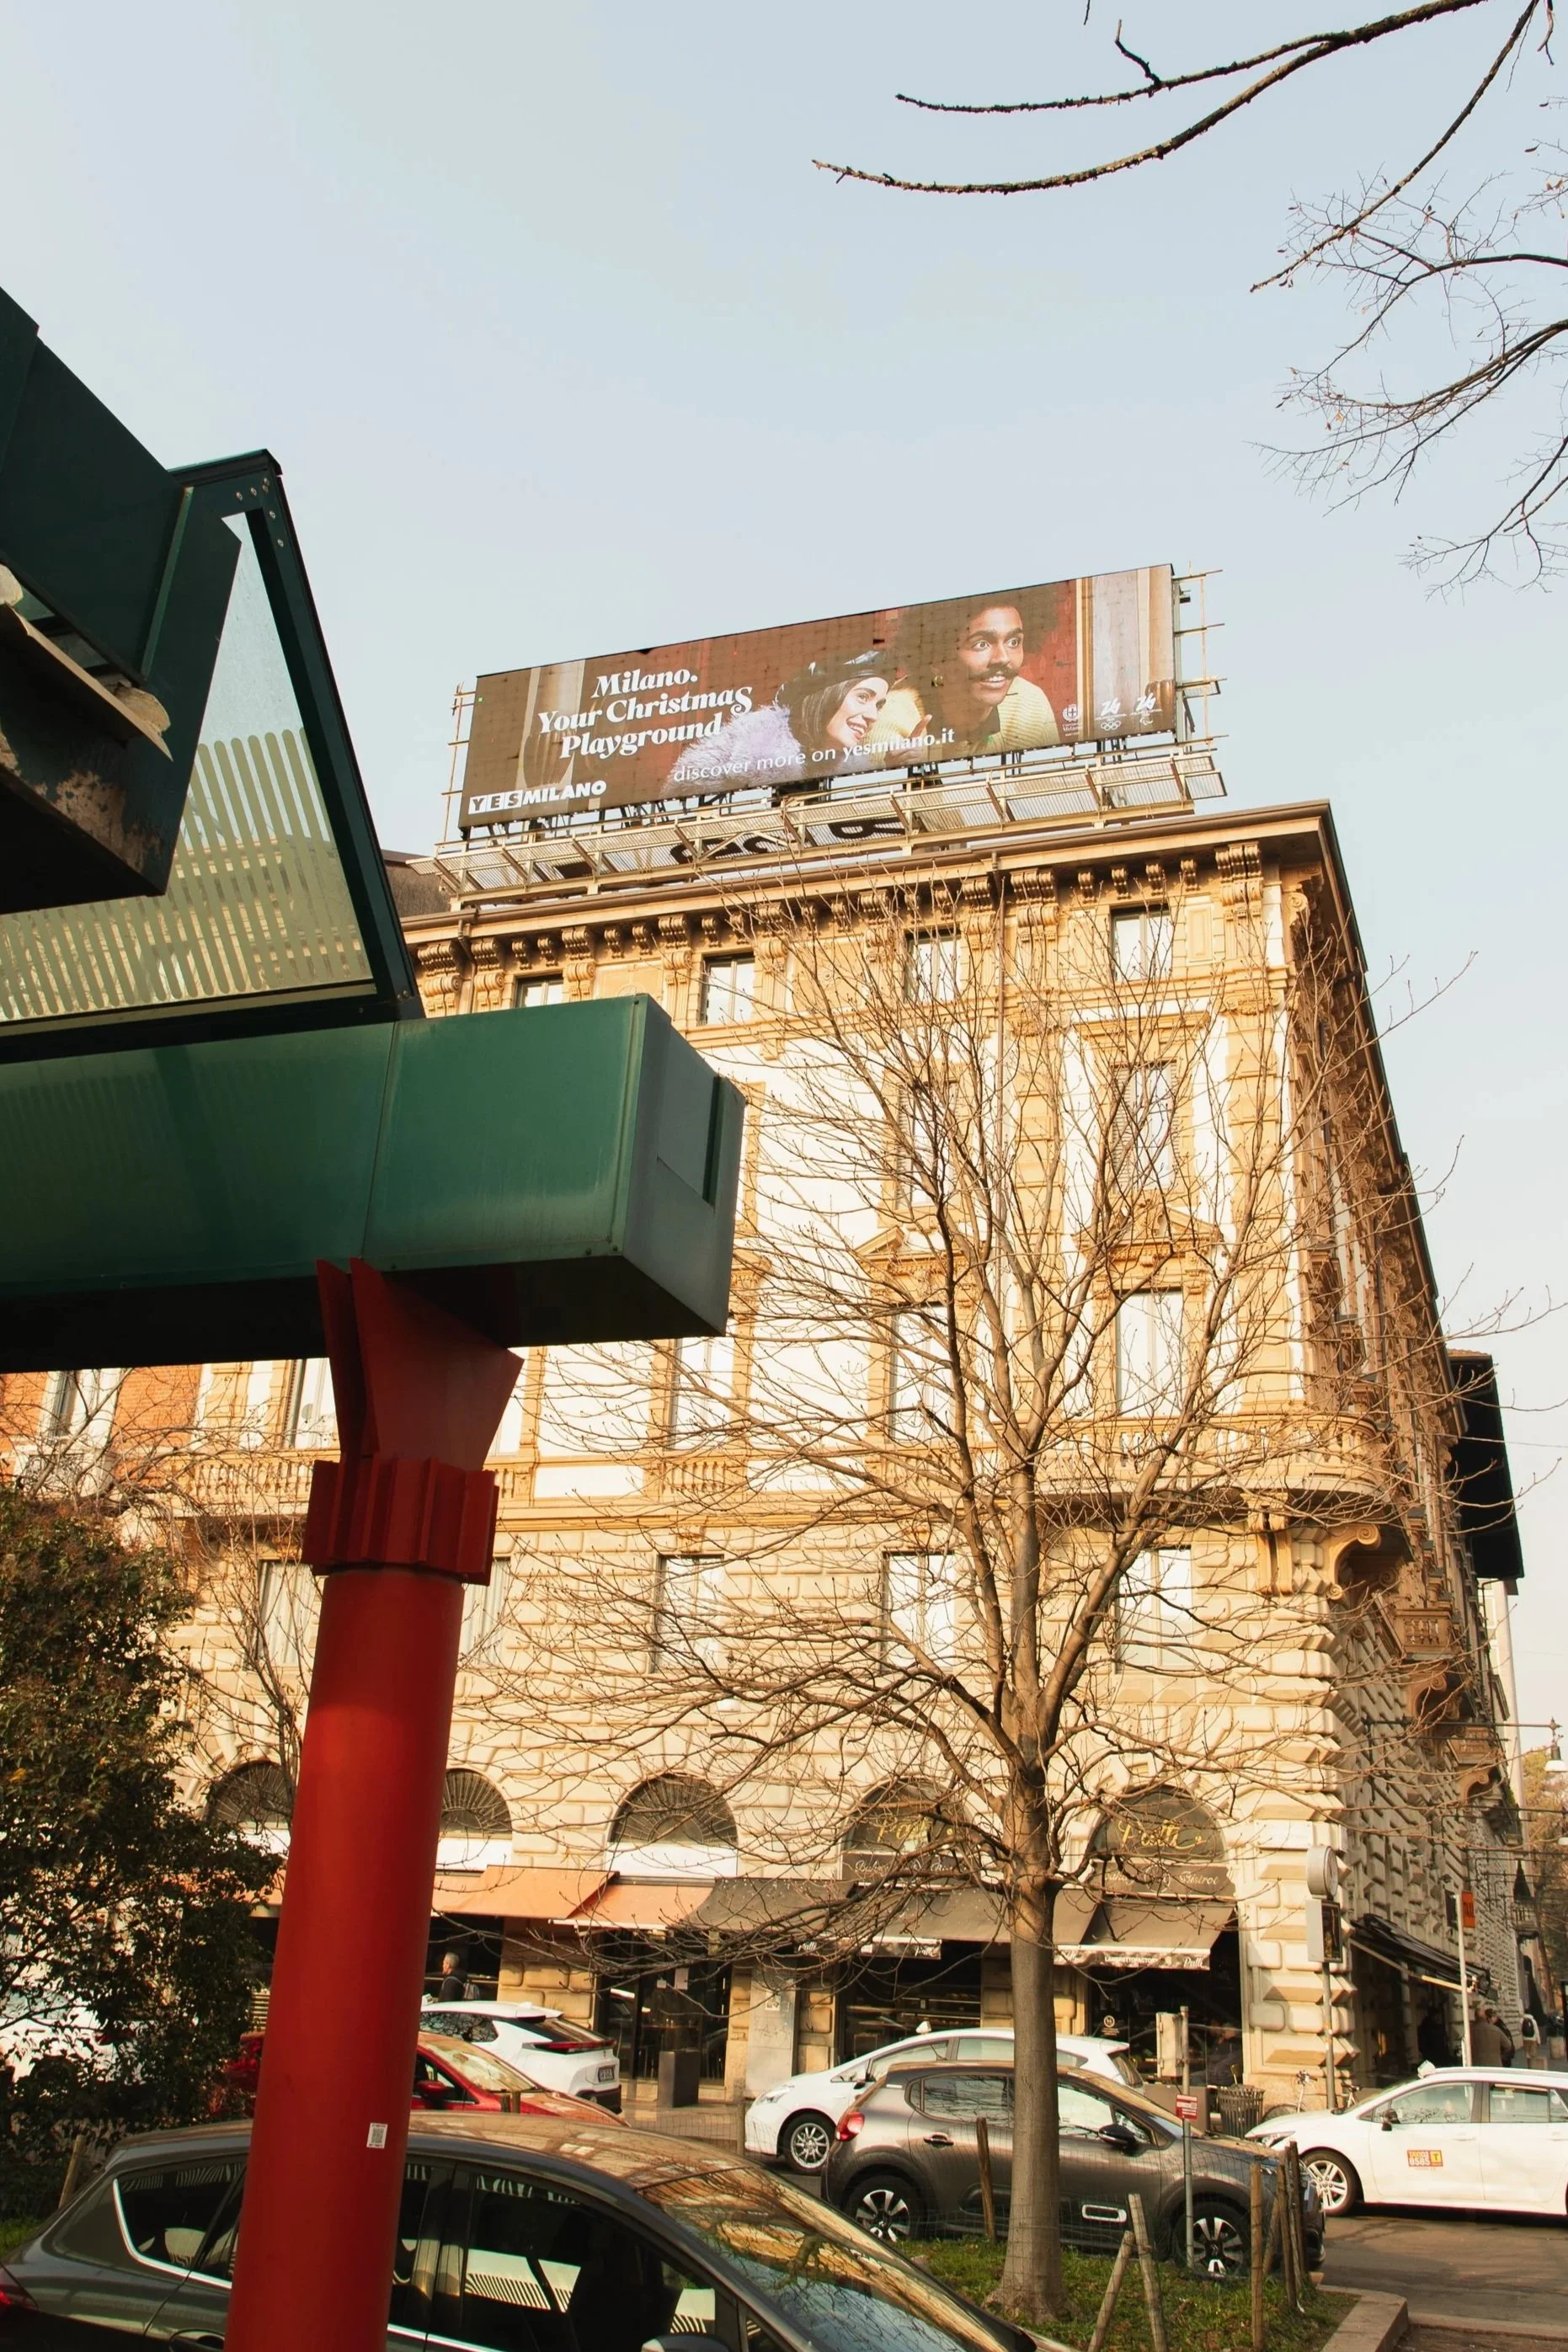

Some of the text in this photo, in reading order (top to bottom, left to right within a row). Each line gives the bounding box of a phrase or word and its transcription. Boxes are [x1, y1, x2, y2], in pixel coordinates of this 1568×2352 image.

[591, 668, 698, 699] Milano.
[537, 686, 753, 734] Your Christmas
[559, 712, 723, 760] Playground
[673, 728, 955, 782] discover more on yesmilano.it
[1432, 2152, 1439, 2162] T
